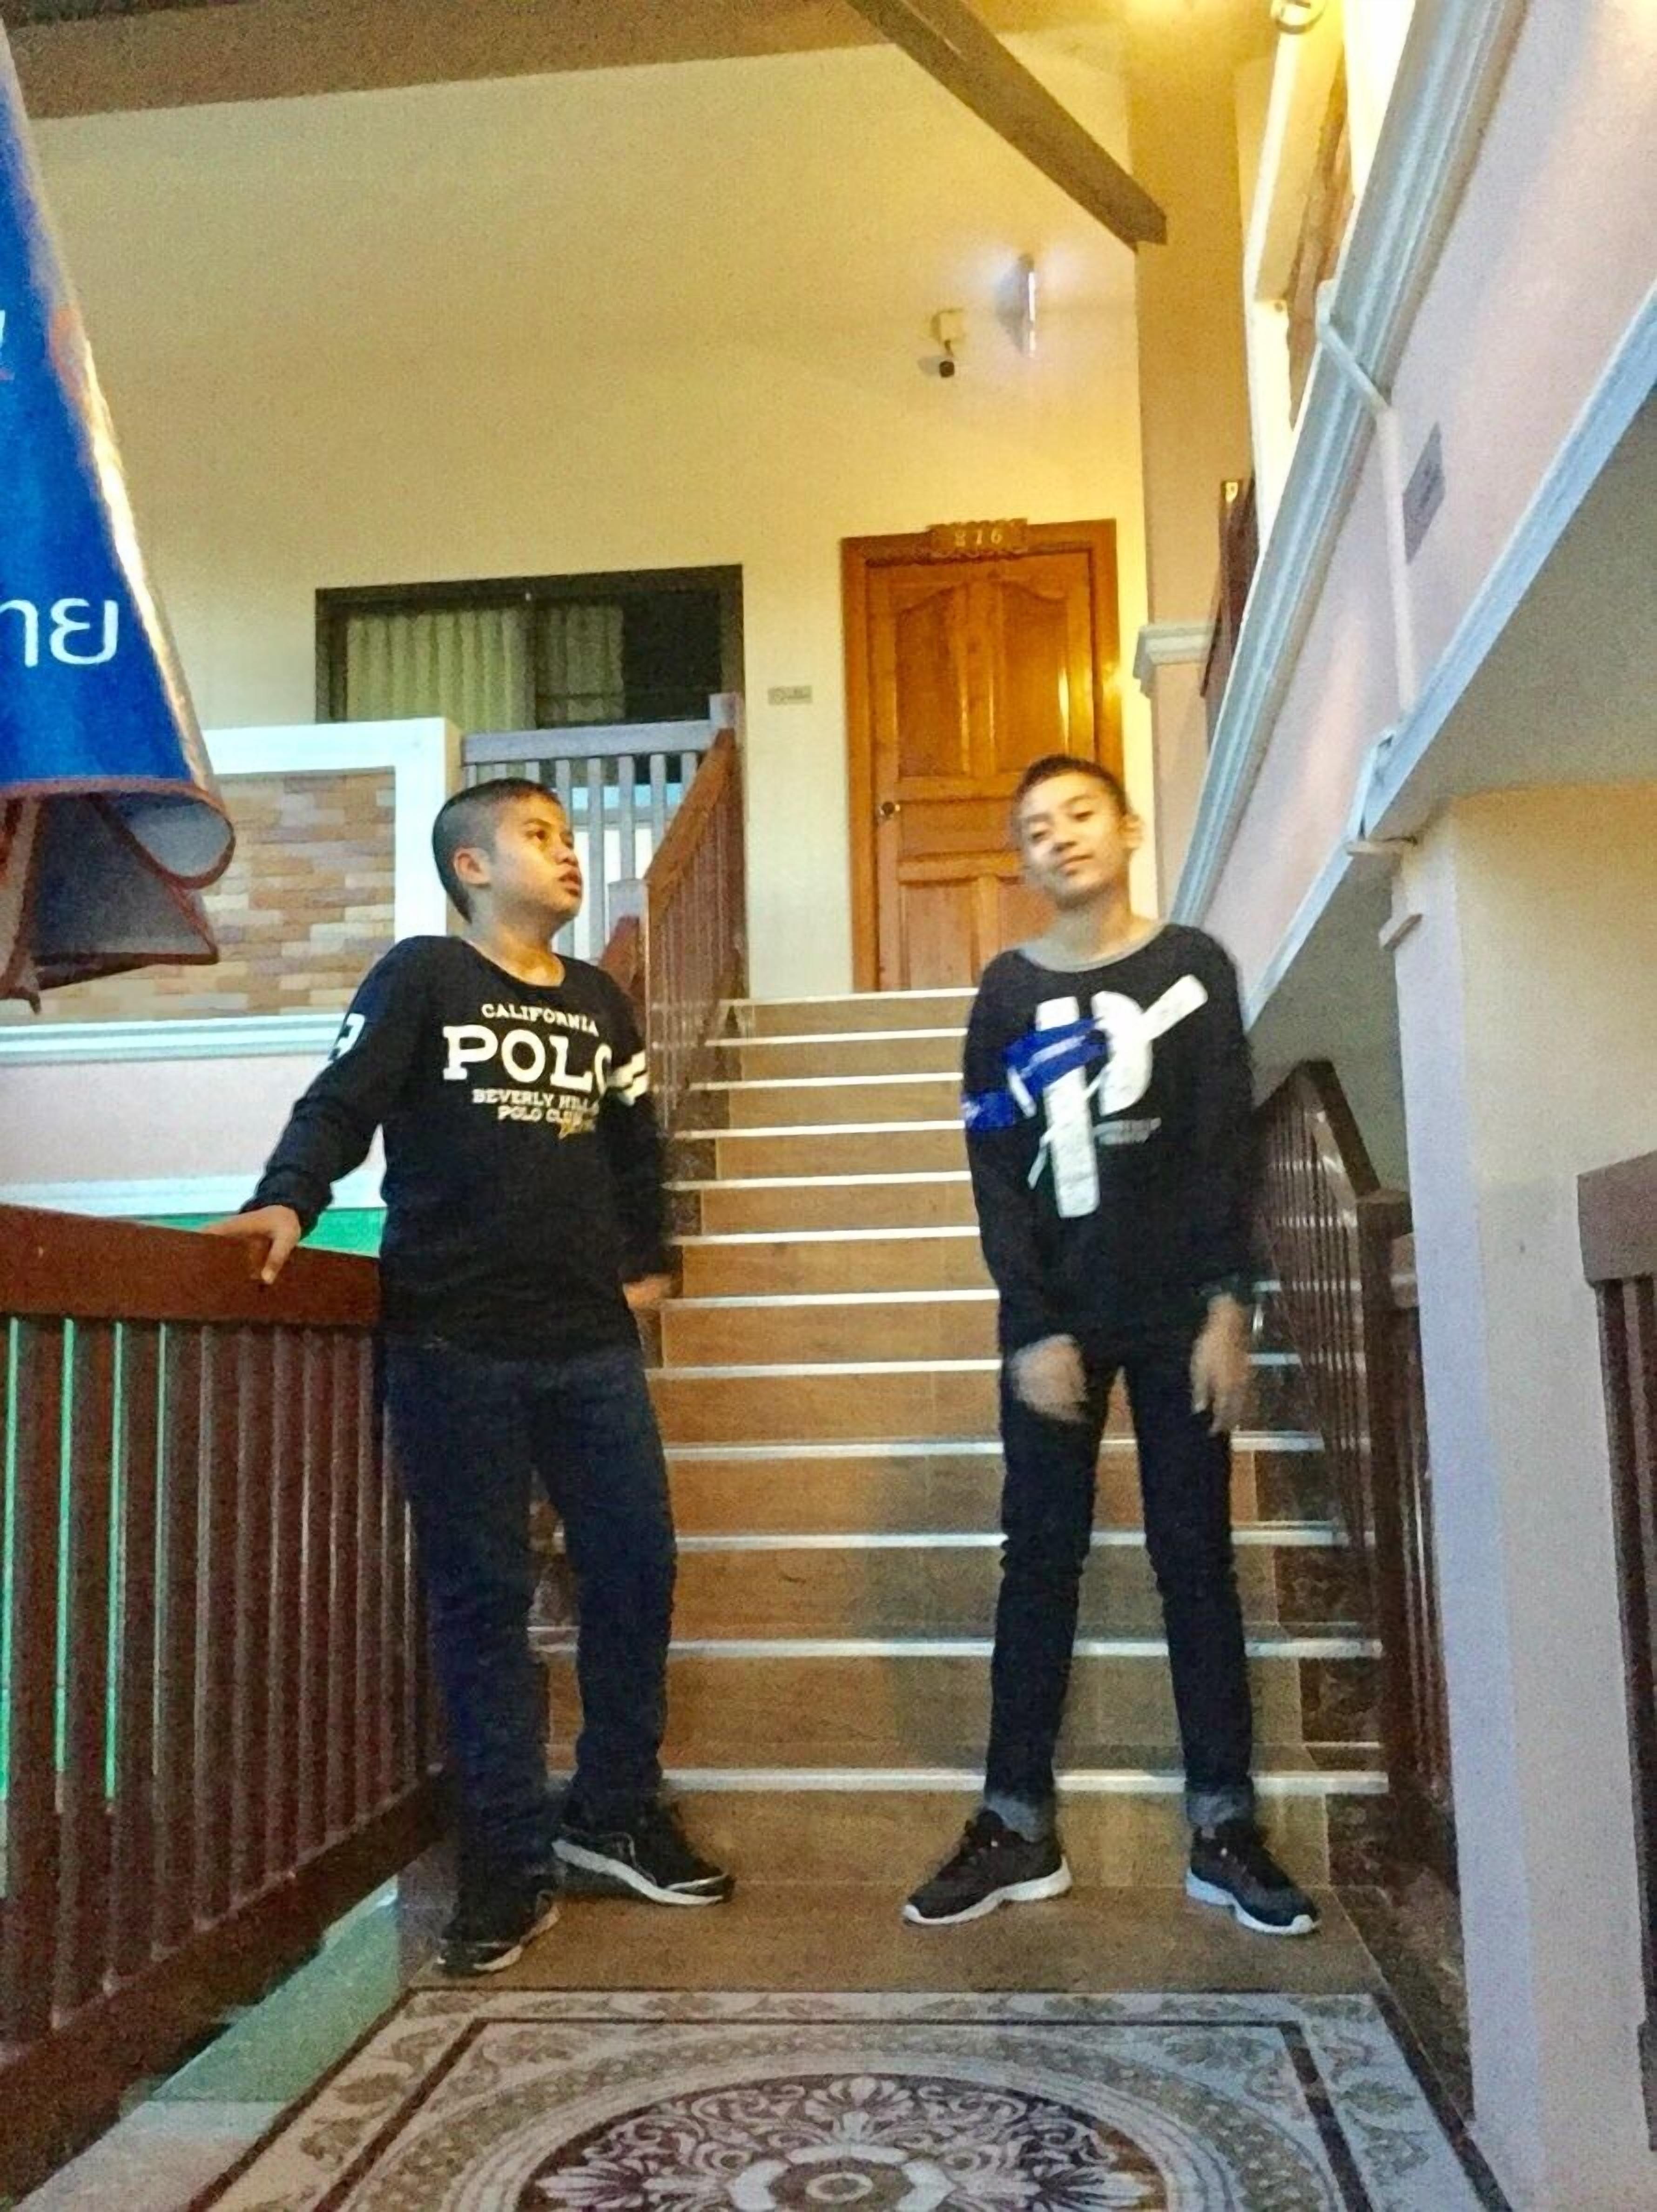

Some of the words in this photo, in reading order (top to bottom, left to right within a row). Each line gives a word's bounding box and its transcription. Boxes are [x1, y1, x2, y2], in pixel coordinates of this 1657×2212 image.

[482, 1004, 599, 1037] CALIFORNIA
[472, 1089, 554, 1107] BEVERLY
[498, 1105, 543, 1122] POLO
